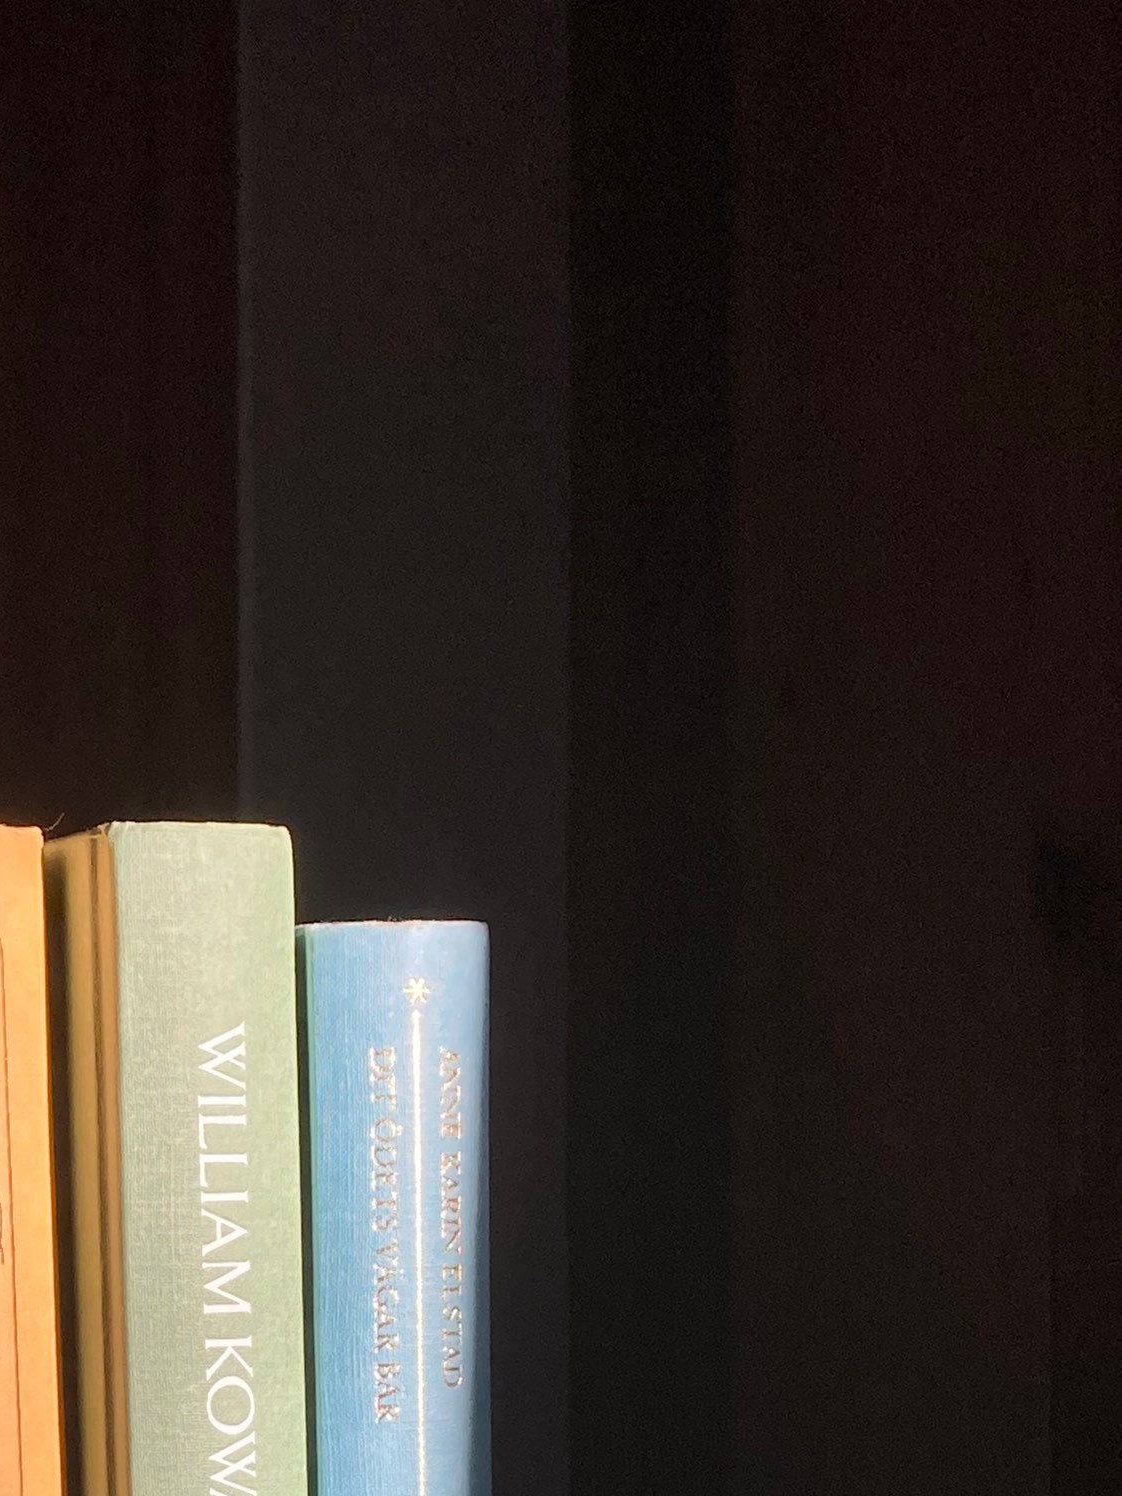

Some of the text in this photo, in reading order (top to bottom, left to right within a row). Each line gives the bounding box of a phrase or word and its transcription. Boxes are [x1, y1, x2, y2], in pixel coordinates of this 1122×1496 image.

[197, 1020, 252, 1316] WILLIAM
[438, 1044, 464, 1390] ANNE KARIN ELSTAD
